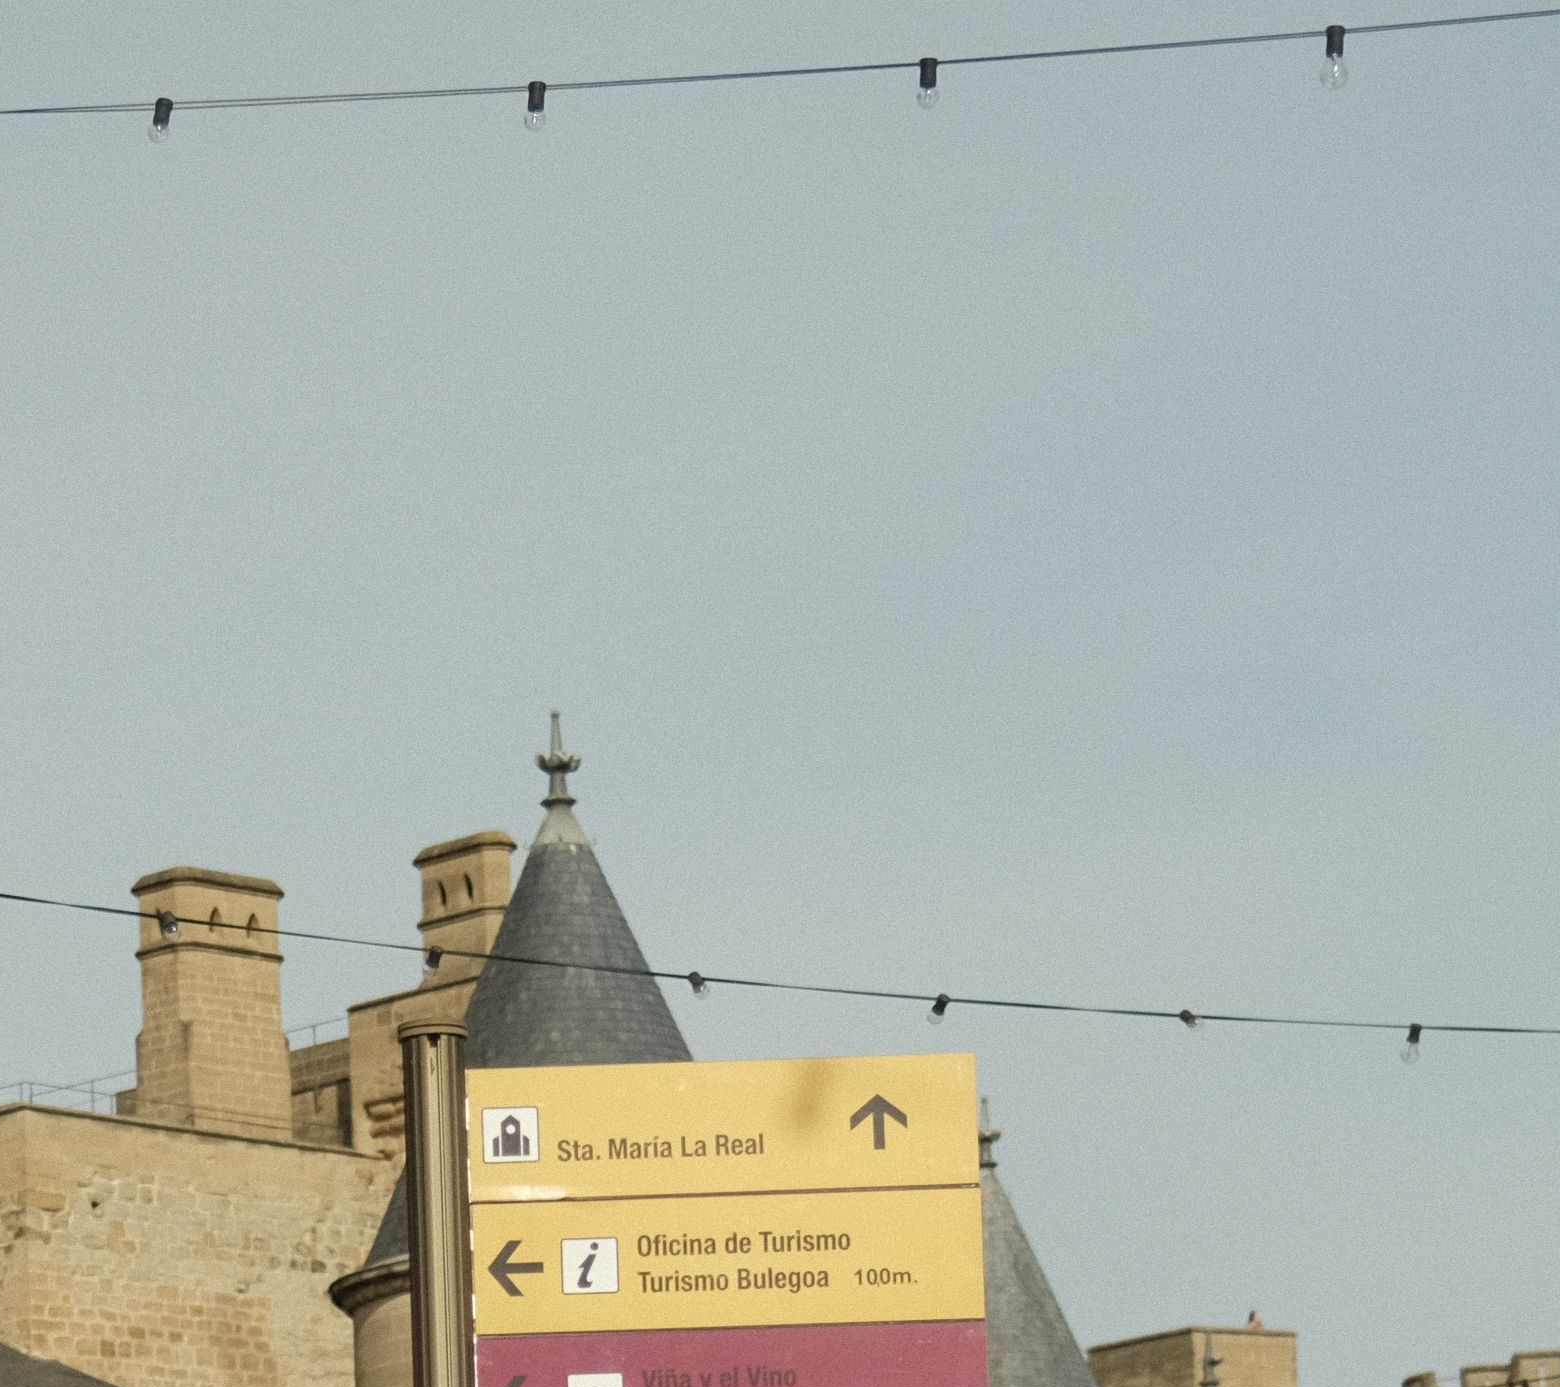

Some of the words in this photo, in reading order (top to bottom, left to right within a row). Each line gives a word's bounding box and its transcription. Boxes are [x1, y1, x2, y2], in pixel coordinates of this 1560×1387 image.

[557, 1139, 602, 1162] Sta.
[608, 1135, 673, 1160] María
[680, 1135, 707, 1158] La
[715, 1133, 764, 1156] Real
[637, 1234, 717, 1258] Oficina
[724, 1232, 752, 1254] de
[758, 1230, 851, 1253] Turismo
[637, 1270, 729, 1294] Turismo
[737, 1267, 829, 1294] Bulegoa
[853, 1267, 919, 1287] 100m.
